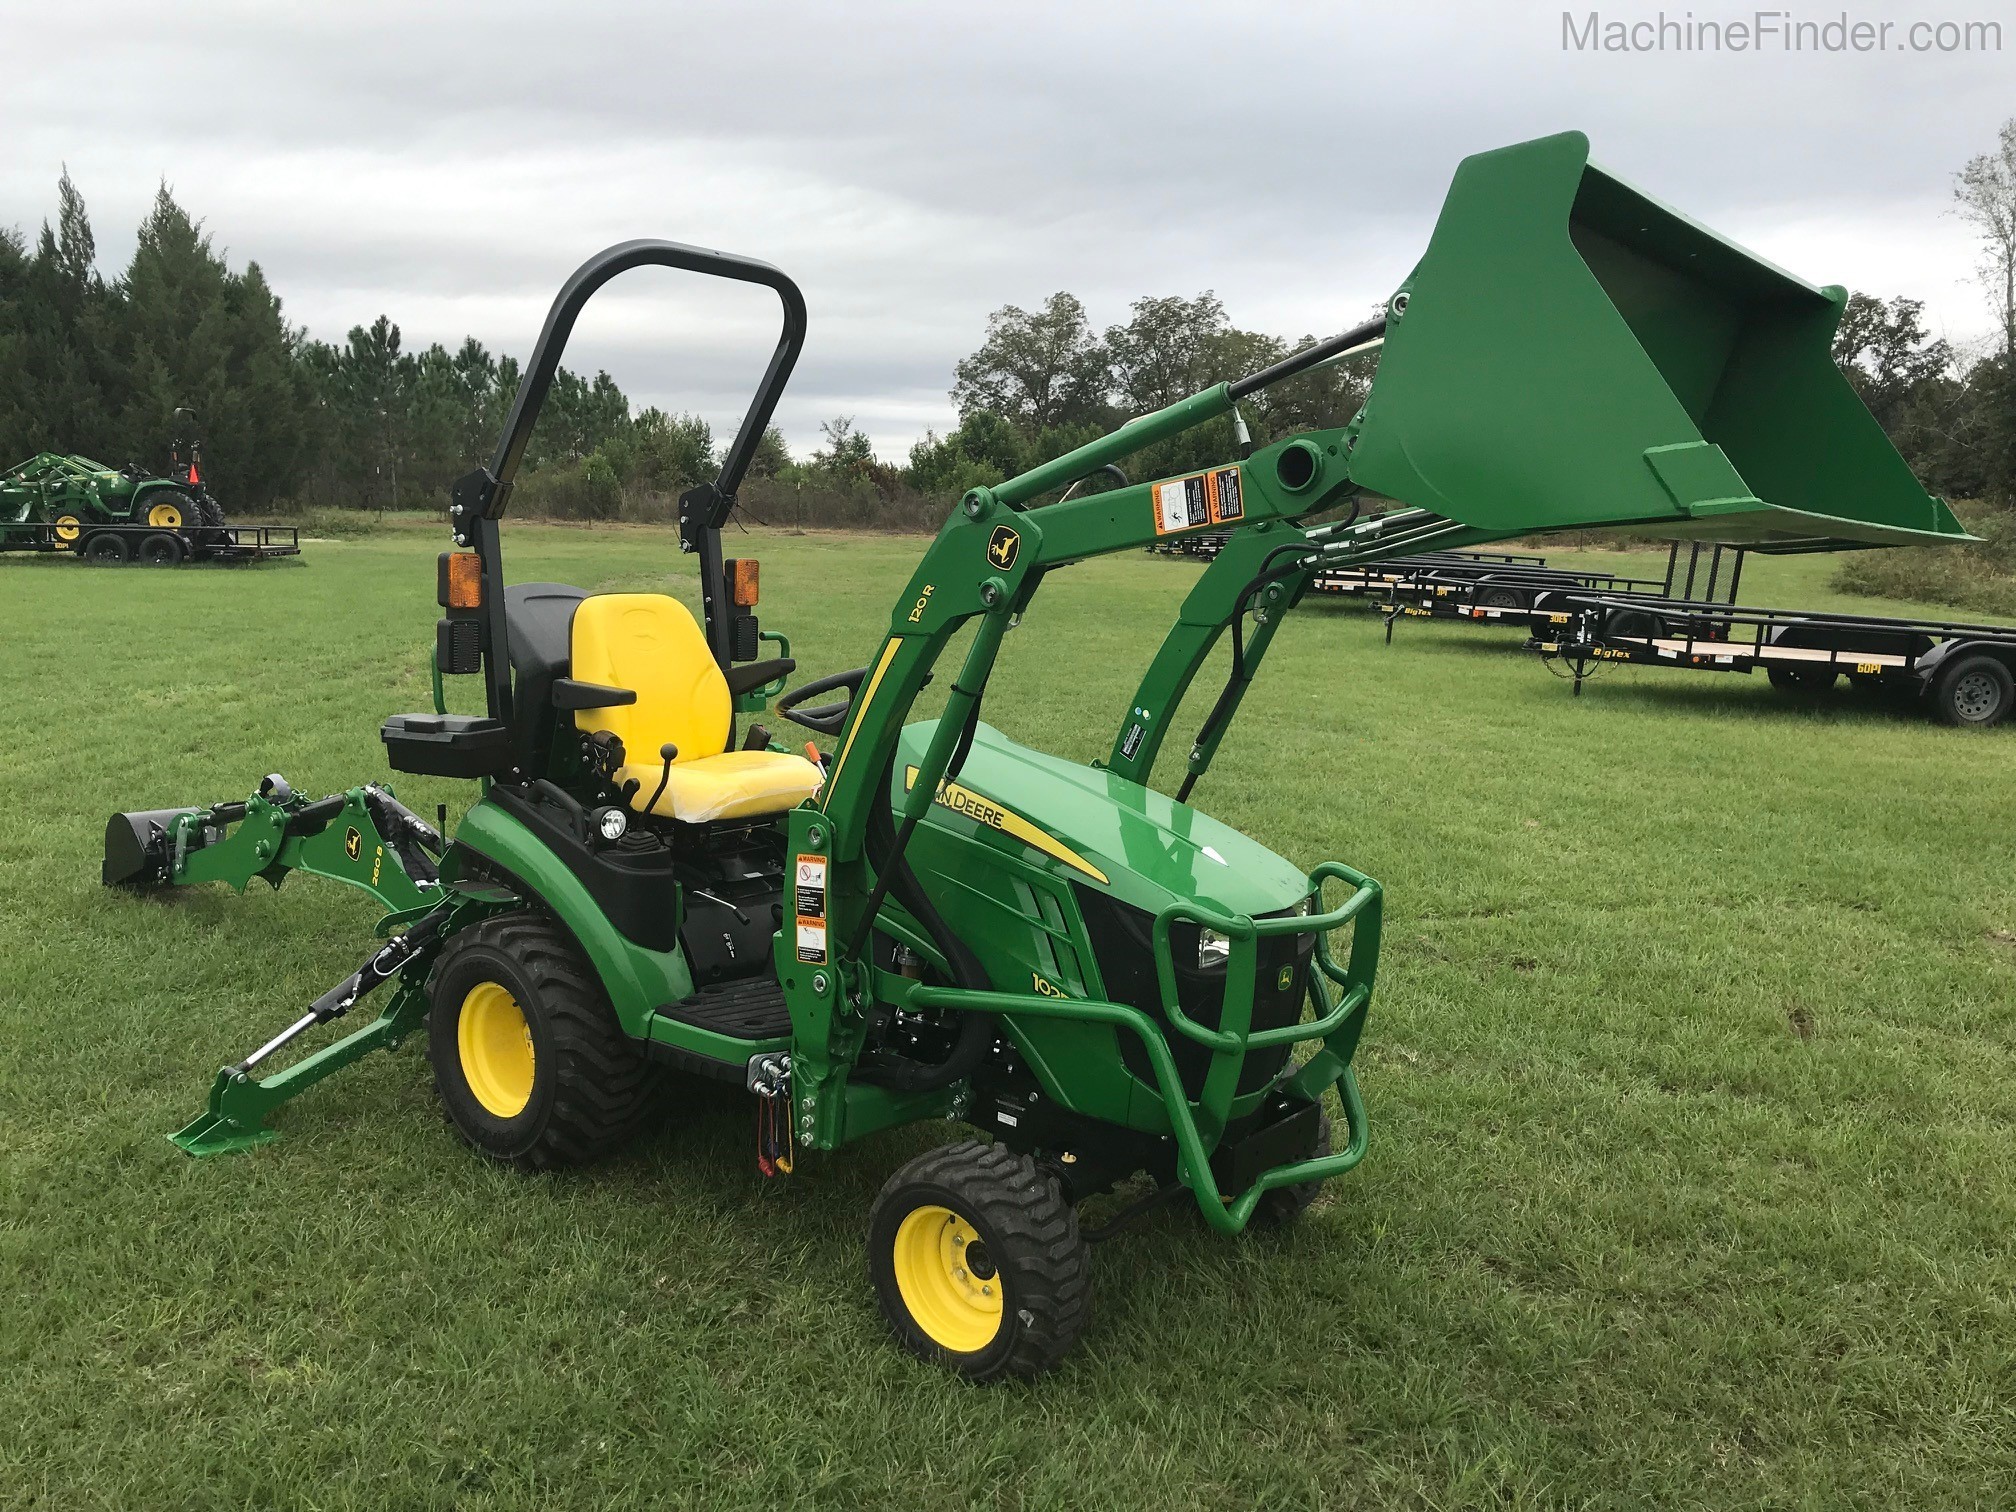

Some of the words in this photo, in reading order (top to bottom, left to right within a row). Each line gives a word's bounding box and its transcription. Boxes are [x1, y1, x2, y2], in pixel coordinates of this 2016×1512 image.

[1154, 490, 1163, 522] WARNING
[1210, 476, 1219, 509] WARNING
[1592, 647, 1631, 659] BgTex
[953, 790, 1005, 828] DEERE
